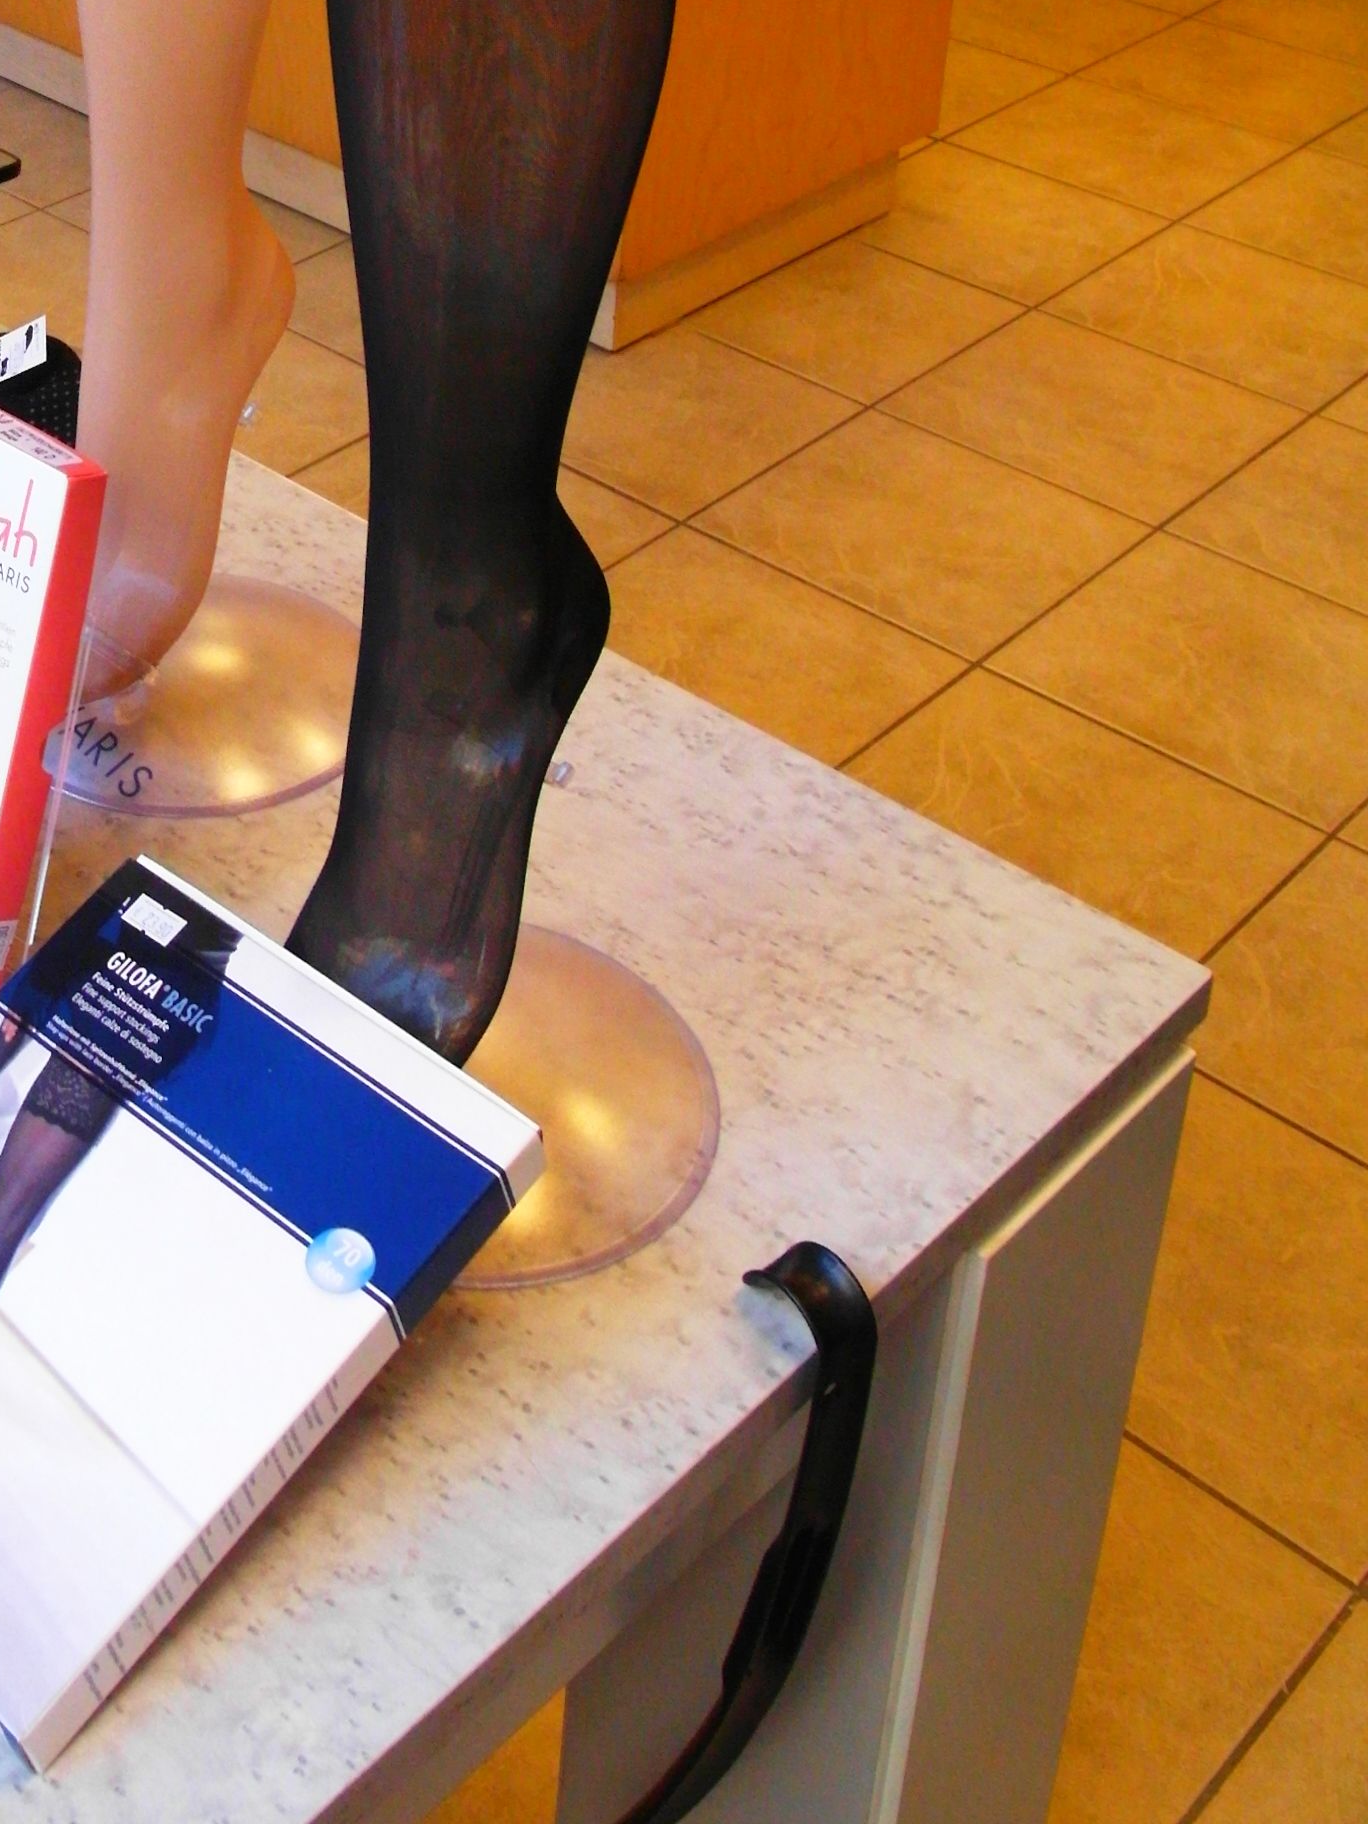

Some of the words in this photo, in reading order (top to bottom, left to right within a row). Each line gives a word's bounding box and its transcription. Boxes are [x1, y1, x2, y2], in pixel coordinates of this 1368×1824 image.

[59, 707, 153, 797] ARIS
[72, 992, 105, 1019] Eleganti
[101, 1015, 121, 1033] calze
[120, 1028, 132, 1040] di
[128, 1034, 163, 1064] sostegno
[82, 982, 99, 998] Fine
[98, 994, 127, 1019] support
[125, 1014, 160, 1044] stockings
[92, 971, 115, 992] Feine
[114, 987, 170, 1032] Stützstrümpfe
[161, 989, 214, 1033] BASIC
